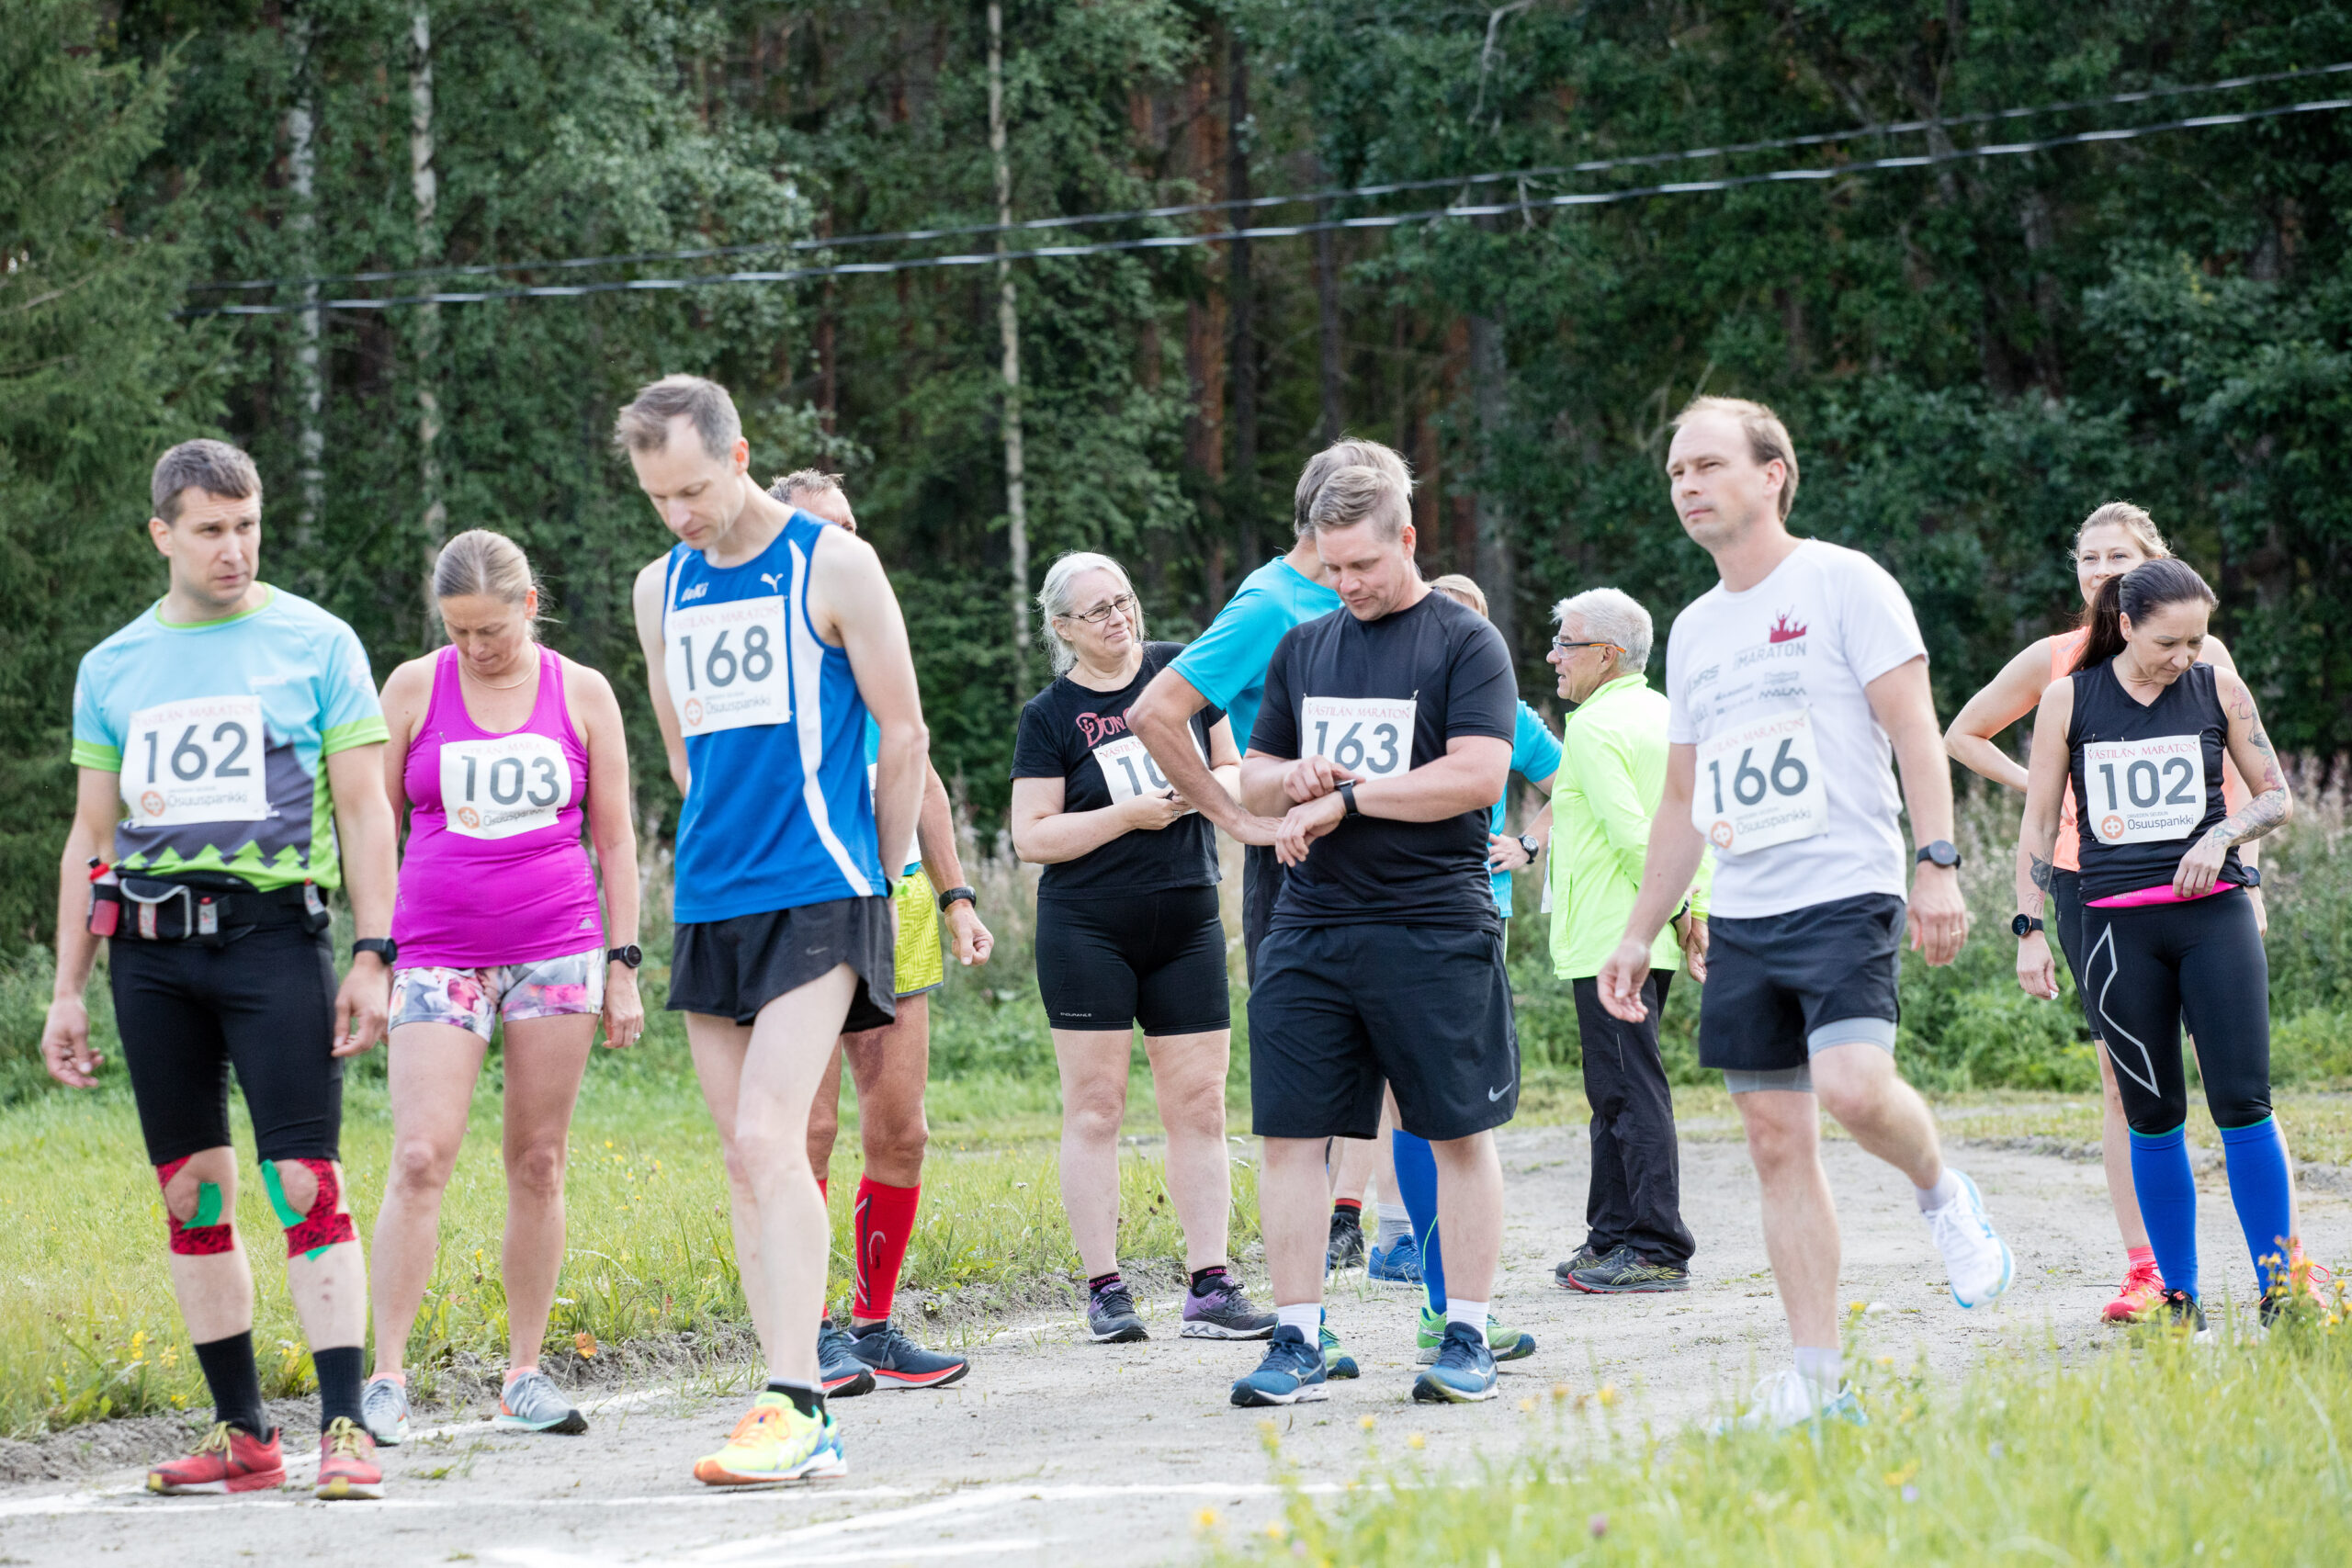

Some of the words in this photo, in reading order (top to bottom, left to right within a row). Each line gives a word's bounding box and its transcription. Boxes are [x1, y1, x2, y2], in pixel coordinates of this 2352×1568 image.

[680, 625, 774, 692] 168
[1307, 705, 1351, 716] VÄSTILÄN
[1359, 706, 1411, 719] MARATON
[1743, 719, 1805, 742] MARATON
[144, 721, 250, 784] 162
[1315, 721, 1399, 774] 163
[2087, 749, 2135, 760] VÄSTILÄN
[2142, 743, 2197, 756] MARATON
[461, 755, 560, 807] 103
[1708, 738, 1808, 815] 166
[2098, 757, 2197, 810] 102
[1736, 808, 1812, 835] Osuuspankki
[2127, 814, 2194, 830] Osuuspankki
